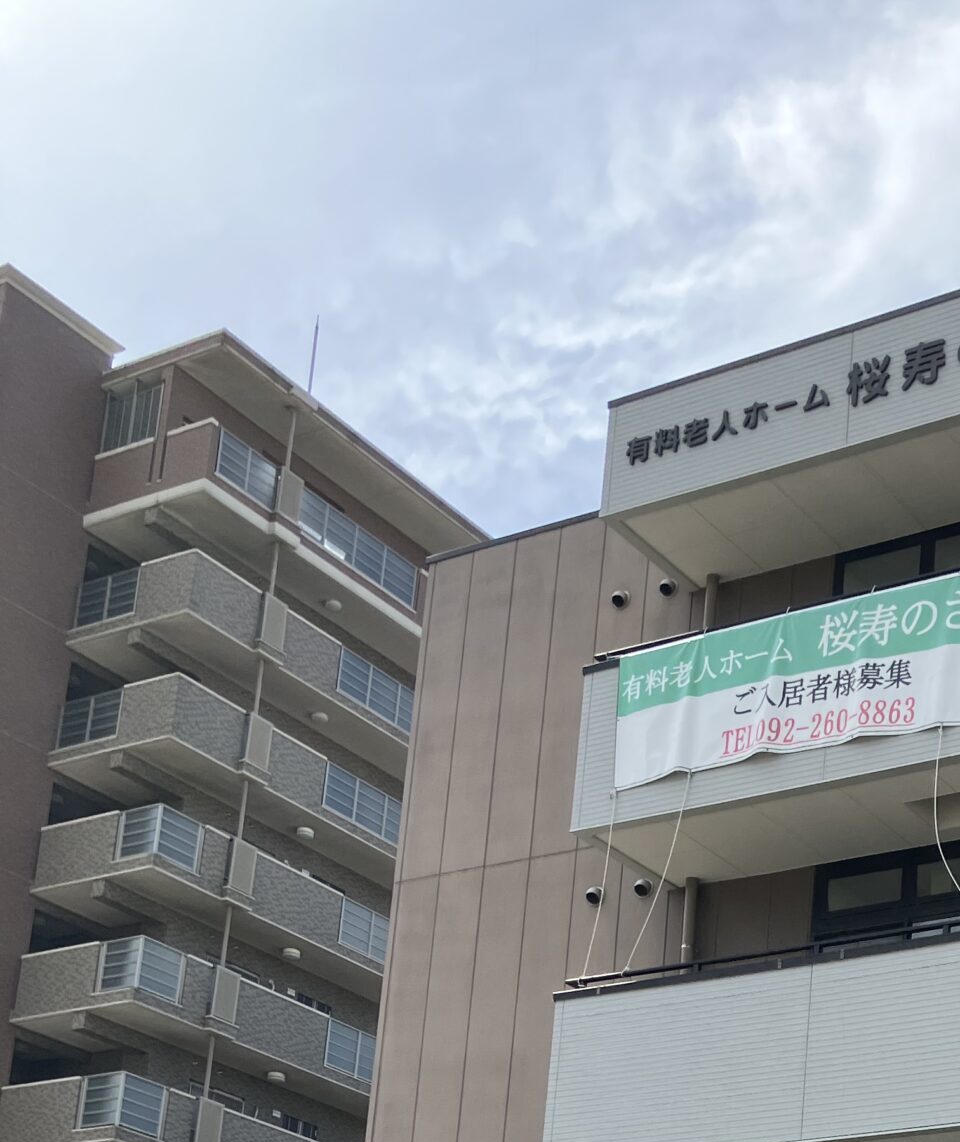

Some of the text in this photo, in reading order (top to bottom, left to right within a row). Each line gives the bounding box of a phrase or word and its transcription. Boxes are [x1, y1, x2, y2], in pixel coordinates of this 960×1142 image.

[625, 383, 830, 466] 有料老人ホーム
[622, 637, 793, 703] 有料老人ホーム
[733, 660, 912, 715] ご入居者様募集
